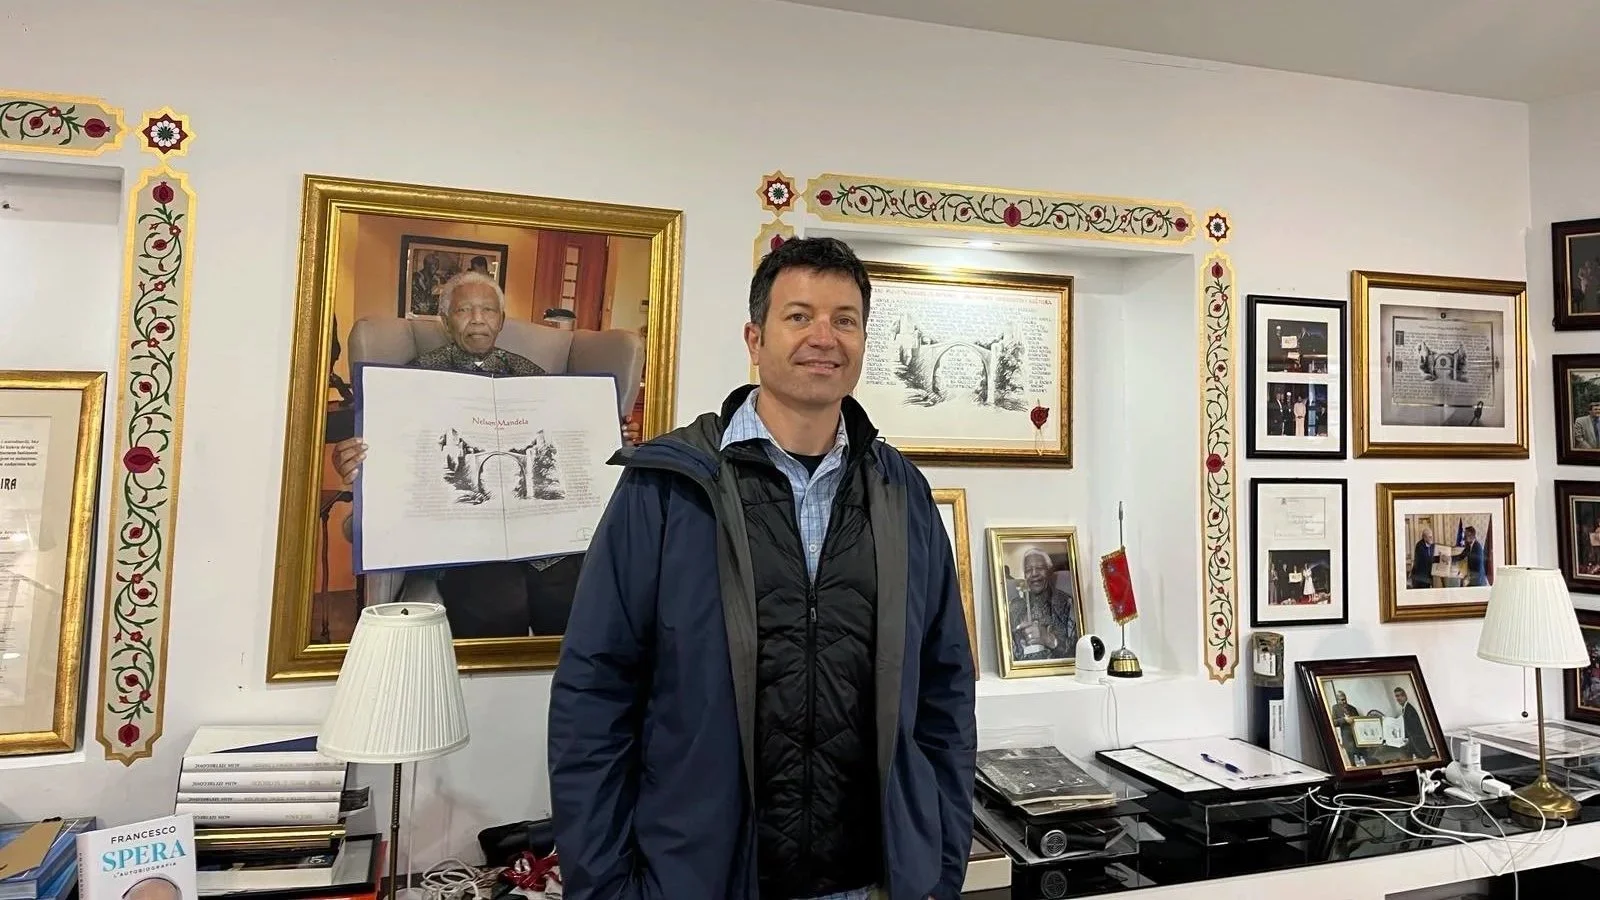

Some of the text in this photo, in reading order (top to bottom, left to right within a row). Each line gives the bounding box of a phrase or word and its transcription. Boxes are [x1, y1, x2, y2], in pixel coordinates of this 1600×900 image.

[472, 417, 529, 427] Nelson Mandela
[111, 826, 176, 844] FRANCESCO
[102, 839, 186, 872] SPERA
[113, 862, 176, 878] L'AUTOBIOGRAFIA
